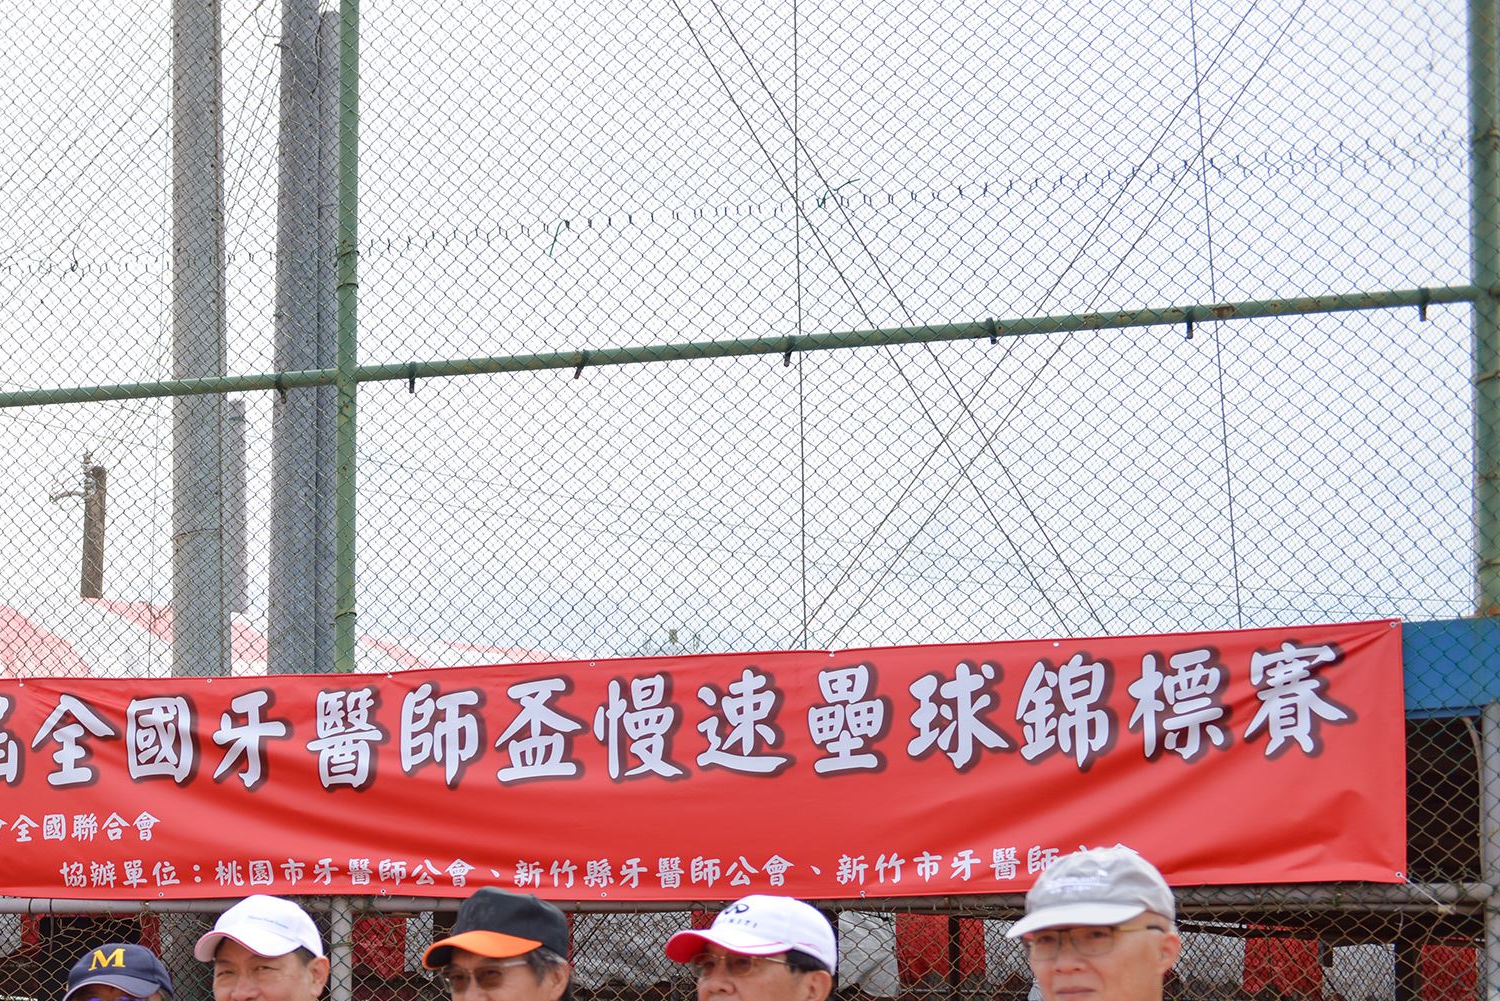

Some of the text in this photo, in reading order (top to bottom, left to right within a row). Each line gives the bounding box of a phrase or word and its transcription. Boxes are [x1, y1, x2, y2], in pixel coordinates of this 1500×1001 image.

[59, 843, 1140, 889] 協辦單位：桃園市牙醫師公會、新竹縣牙醫師公會、新竹市牙醫師
[88, 948, 126, 972] M
